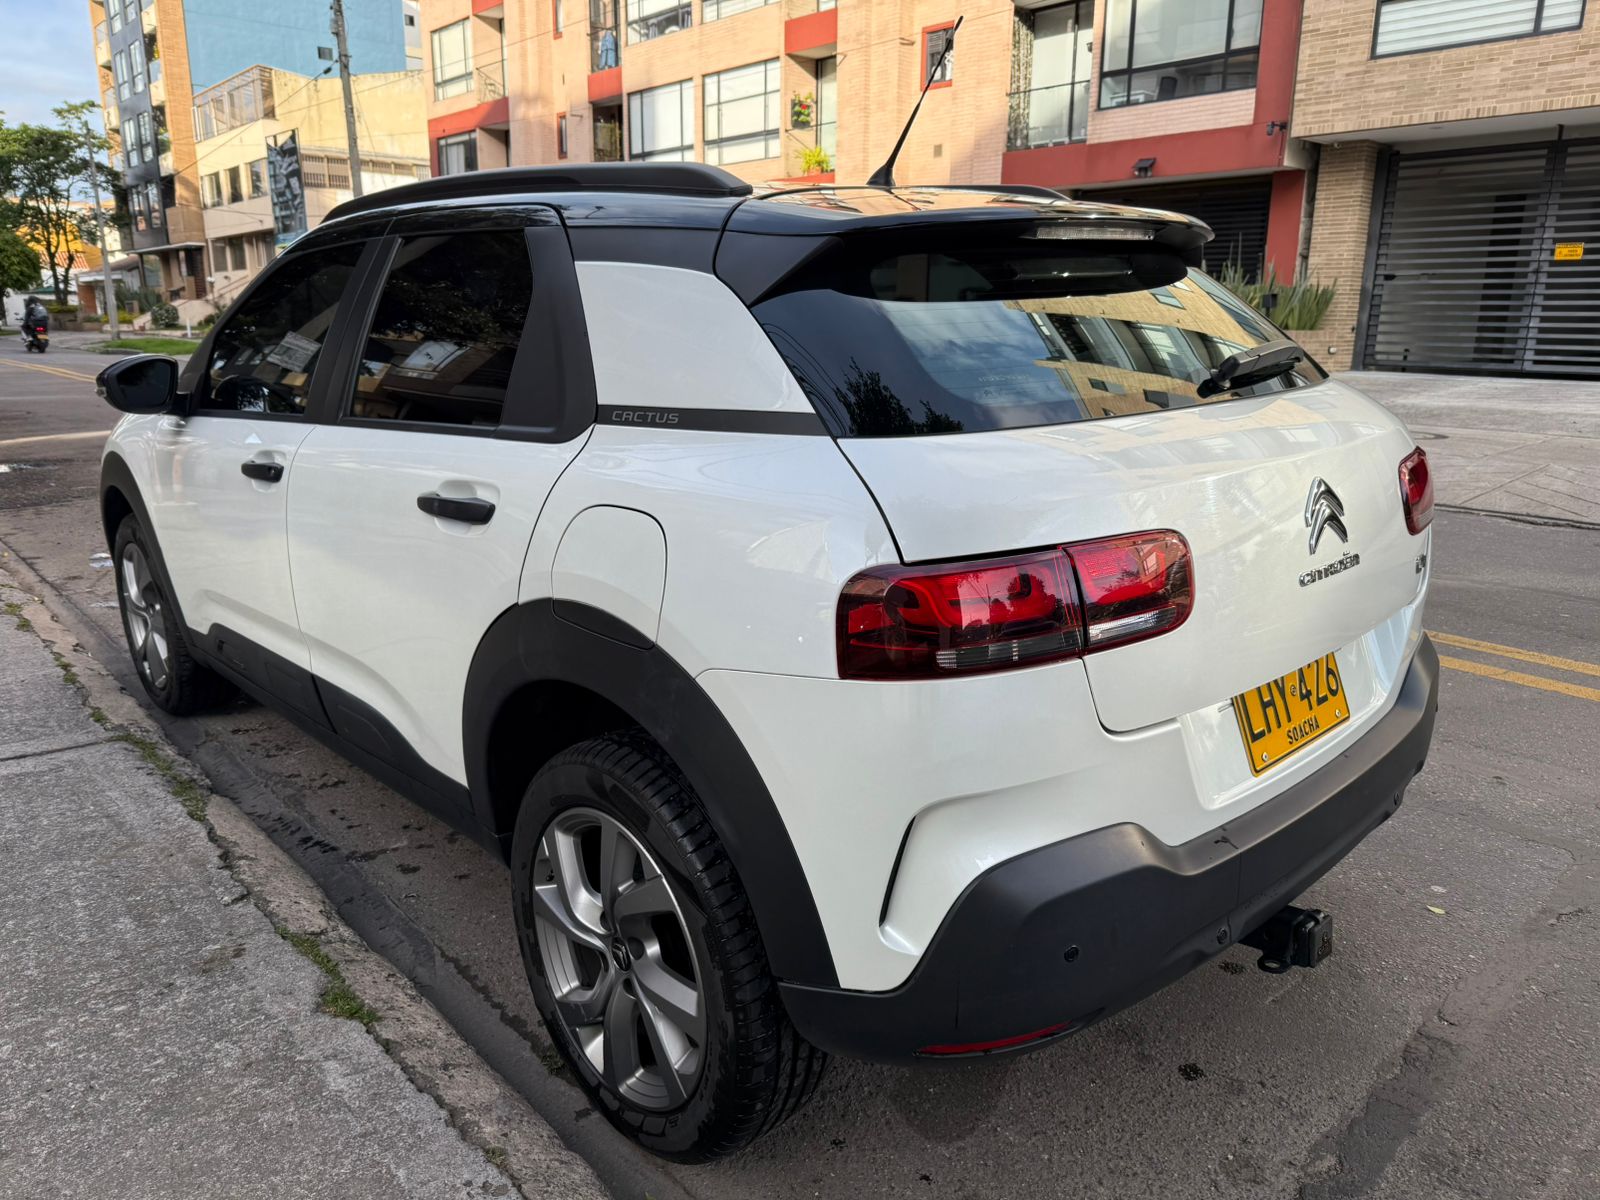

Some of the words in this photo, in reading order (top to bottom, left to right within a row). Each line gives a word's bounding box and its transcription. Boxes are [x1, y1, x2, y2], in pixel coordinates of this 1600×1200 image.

[612, 410, 679, 424] CACTUS
[1238, 676, 1292, 743] LHY
[1286, 715, 1320, 745] SOACHA
